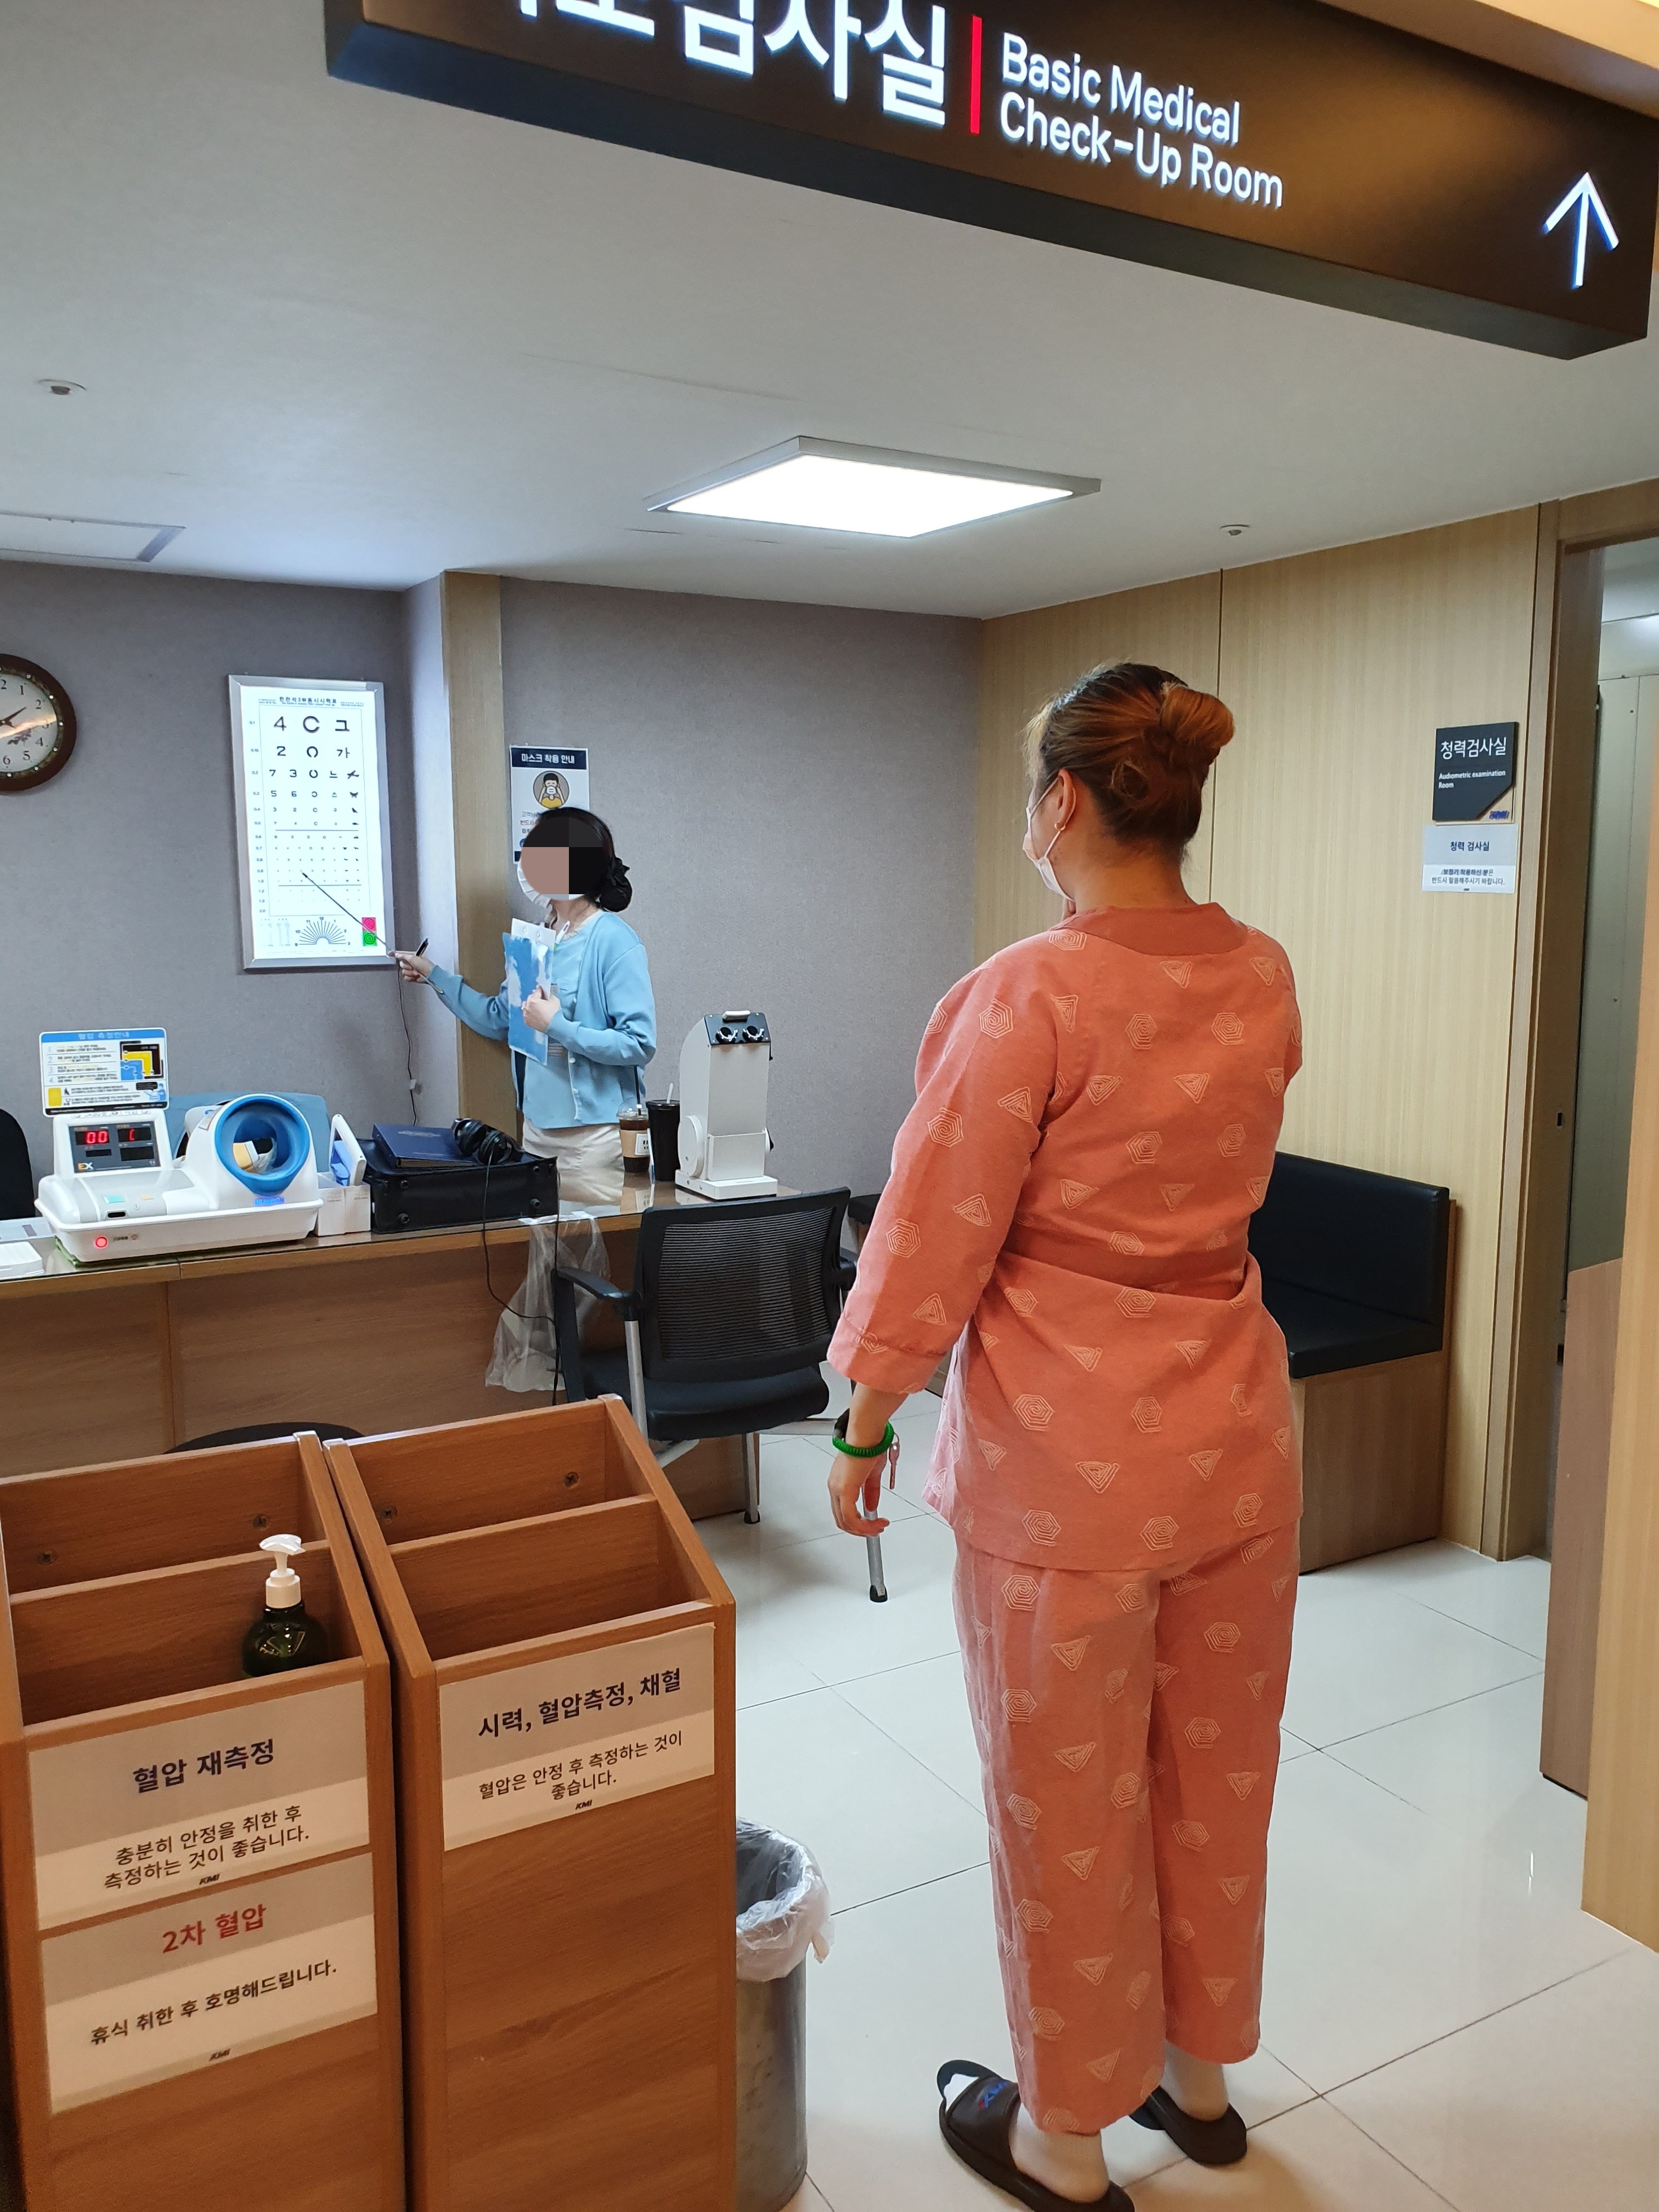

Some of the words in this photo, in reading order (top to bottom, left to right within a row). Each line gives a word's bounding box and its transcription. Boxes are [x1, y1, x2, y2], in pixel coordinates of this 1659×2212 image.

[1002, 32, 1102, 108] Basic
[1110, 64, 1240, 146] Medical
[1000, 91, 1182, 188] Check-Up
[1190, 142, 1283, 208] Room
[19, 685, 25, 695] 1
[35, 699, 42, 709] 2
[273, 716, 287, 731] 4
[36, 737, 43, 747] 4
[1440, 736, 1507, 760] 청력검사실
[23, 751, 31, 761] 5
[276, 746, 286, 757] 2
[336, 747, 351, 759] 가
[521, 753, 543, 763] 마스크
[545, 754, 559, 763] 착용
[561, 755, 575, 764] 안내
[3, 755, 11, 765] 6
[290, 769, 297, 777] 3
[1438, 771, 1471, 780] Audiometric
[1472, 770, 1506, 778] examination
[1450, 841, 1465, 851] 청력
[1467, 841, 1490, 851] 검사실
[77, 1162, 94, 1171] EX
[478, 1708, 532, 1738] 시력,
[539, 1682, 634, 1725] 혈압측정,
[639, 1668, 681, 1697] 채혈
[133, 1759, 187, 1793] 혈압
[197, 1739, 274, 1775] 재측정
[479, 1773, 527, 1800] 혈압은
[533, 1763, 563, 1786] 안정
[568, 1758, 584, 1774] 후
[589, 1742, 648, 1768] 측정하는
[654, 1730, 682, 1753] 것이
[551, 1769, 617, 1800] 좋습니다.
[575, 1799, 593, 1810] KMI
[115, 1838, 173, 1865] 충분히
[180, 1821, 236, 1850] 안정을
[242, 1810, 278, 1833] 취한
[285, 1805, 302, 1823] 후
[104, 1860, 182, 1889] 측정하는
[189, 1843, 224, 1871] 것이
[232, 1826, 309, 1859] 좋습니다.
[199, 1874, 221, 1886] KMI
[162, 1921, 206, 1955] 2차
[215, 1904, 267, 1939] 혈압
[91, 2019, 128, 2045] 휴식
[136, 2006, 174, 2030] 취한
[180, 2000, 199, 2018] 후
[205, 1960, 337, 2011] 호명해드립니다.
